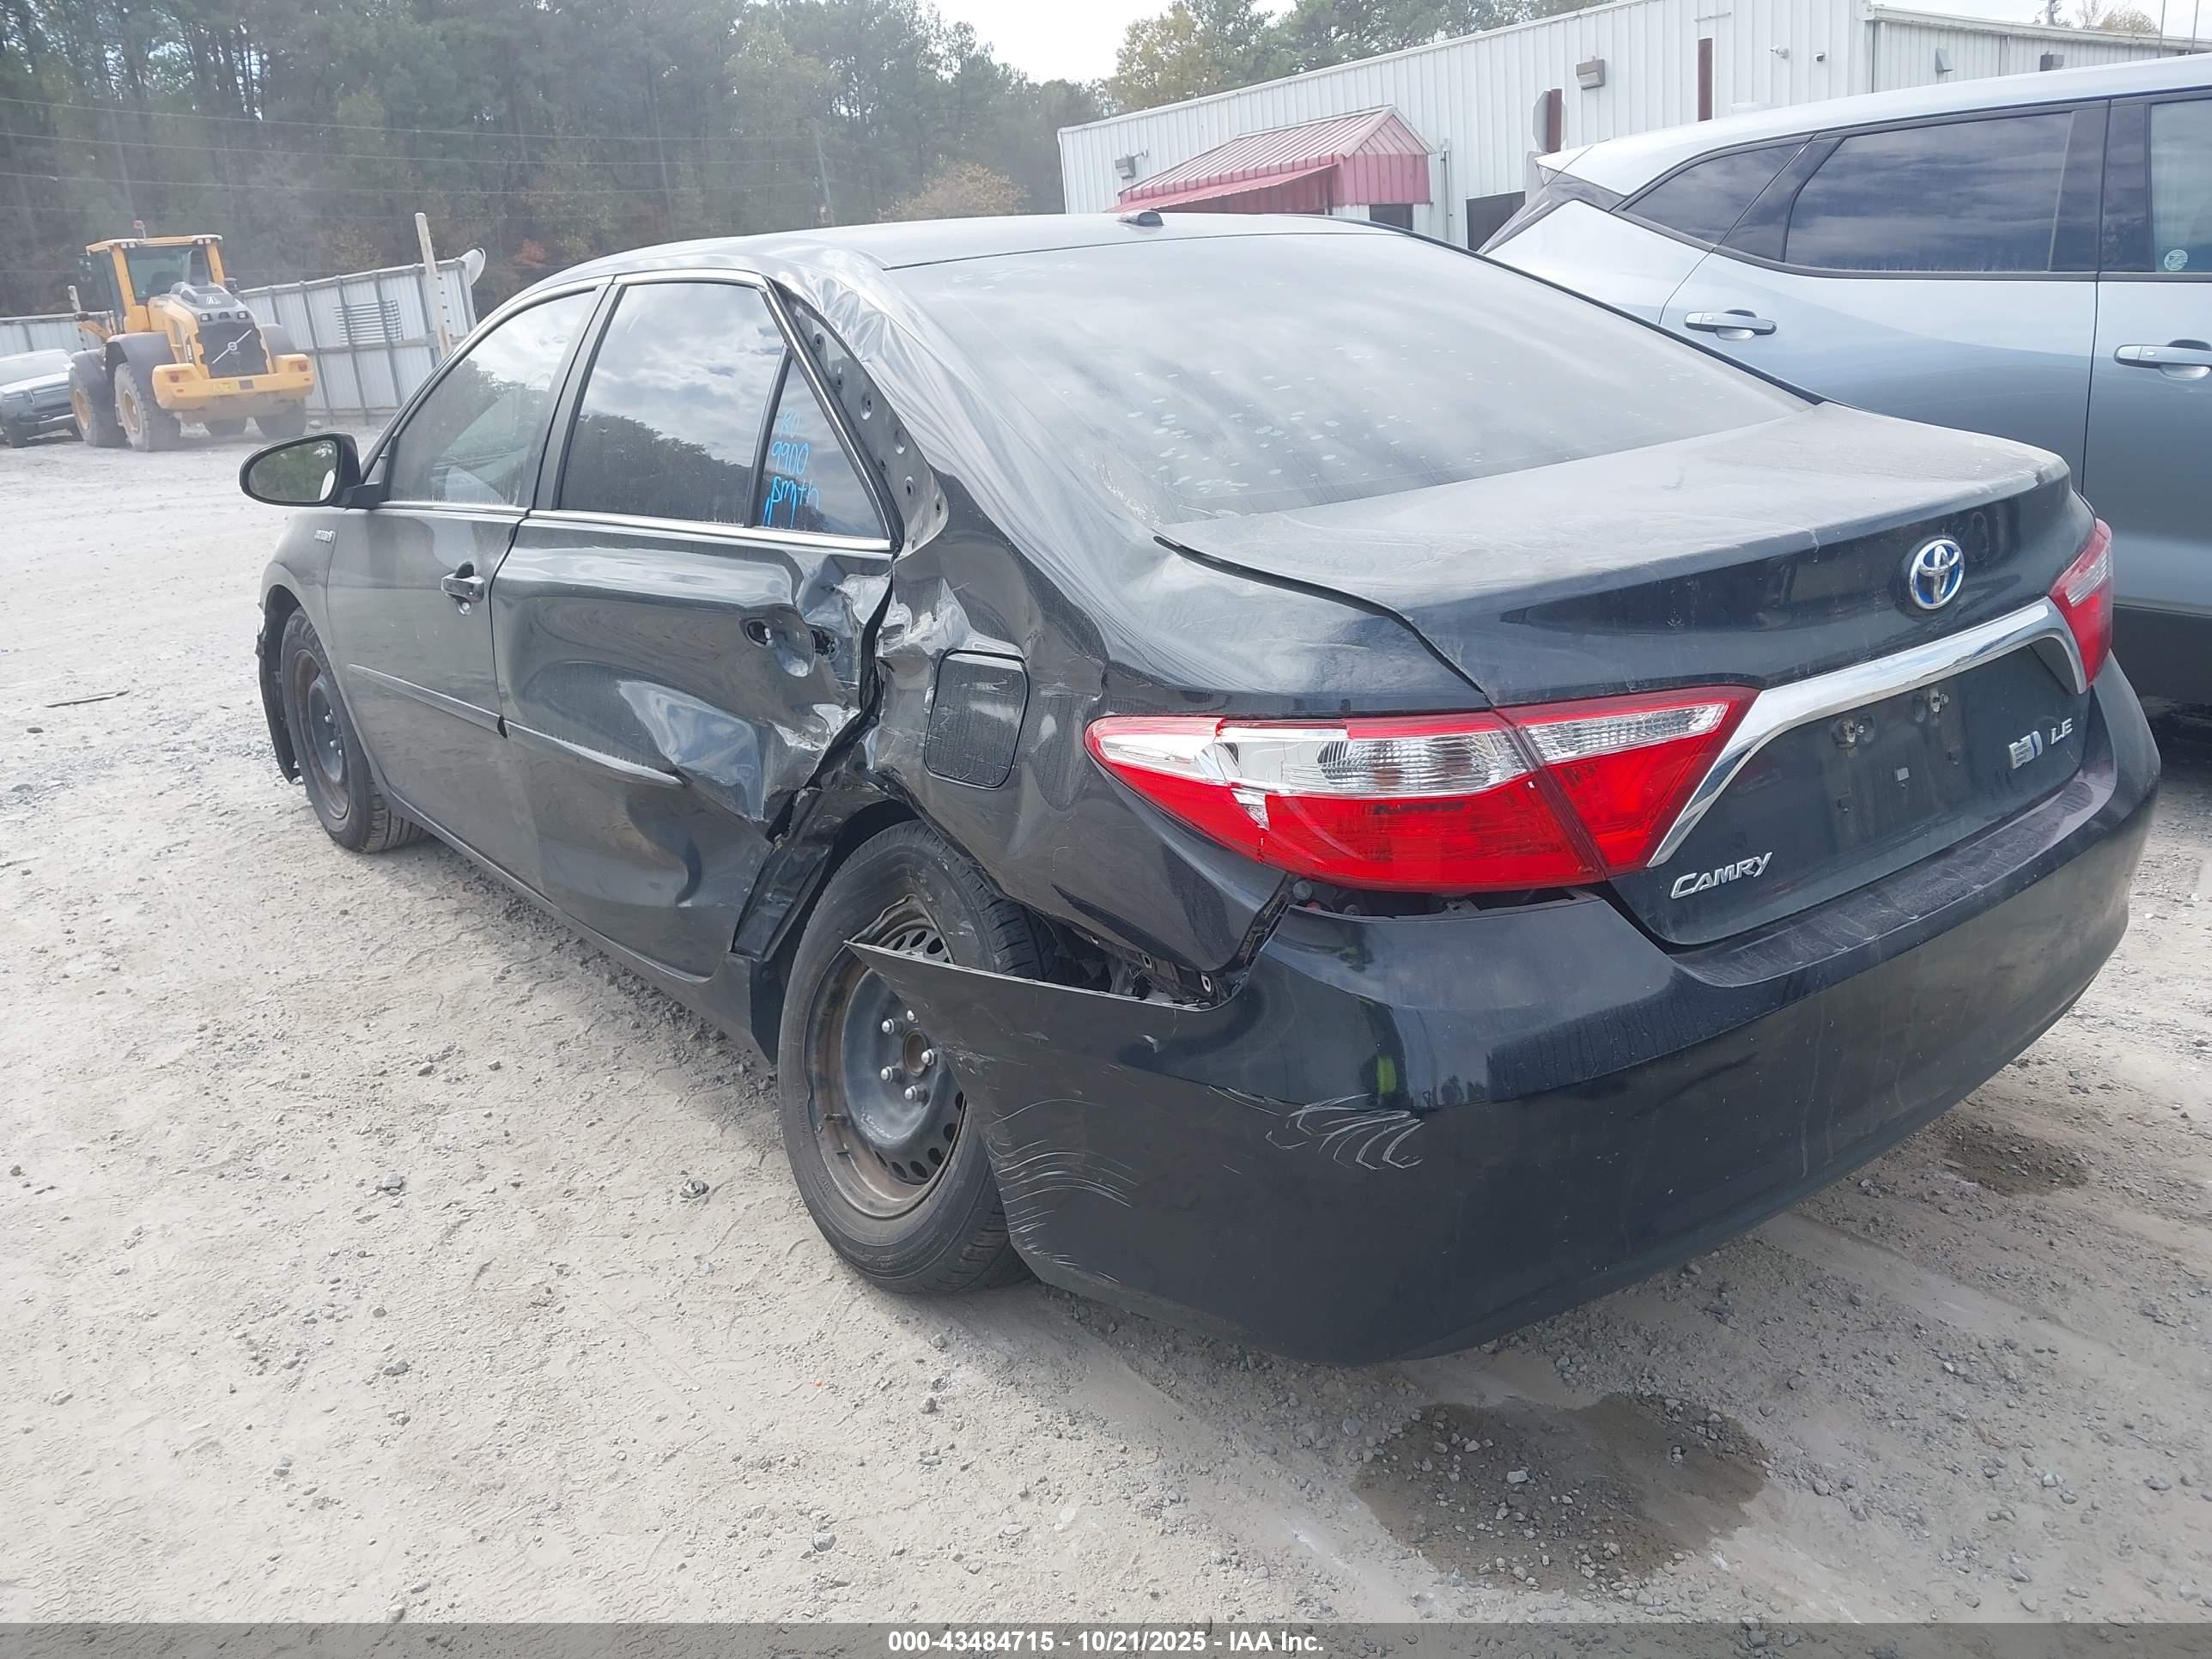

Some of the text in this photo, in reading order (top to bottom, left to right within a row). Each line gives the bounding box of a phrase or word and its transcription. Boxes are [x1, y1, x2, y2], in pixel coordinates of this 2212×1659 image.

[771, 440, 810, 476] 9900
[2051, 717, 2073, 744] LE
[1669, 851, 1773, 900] CAMRY
